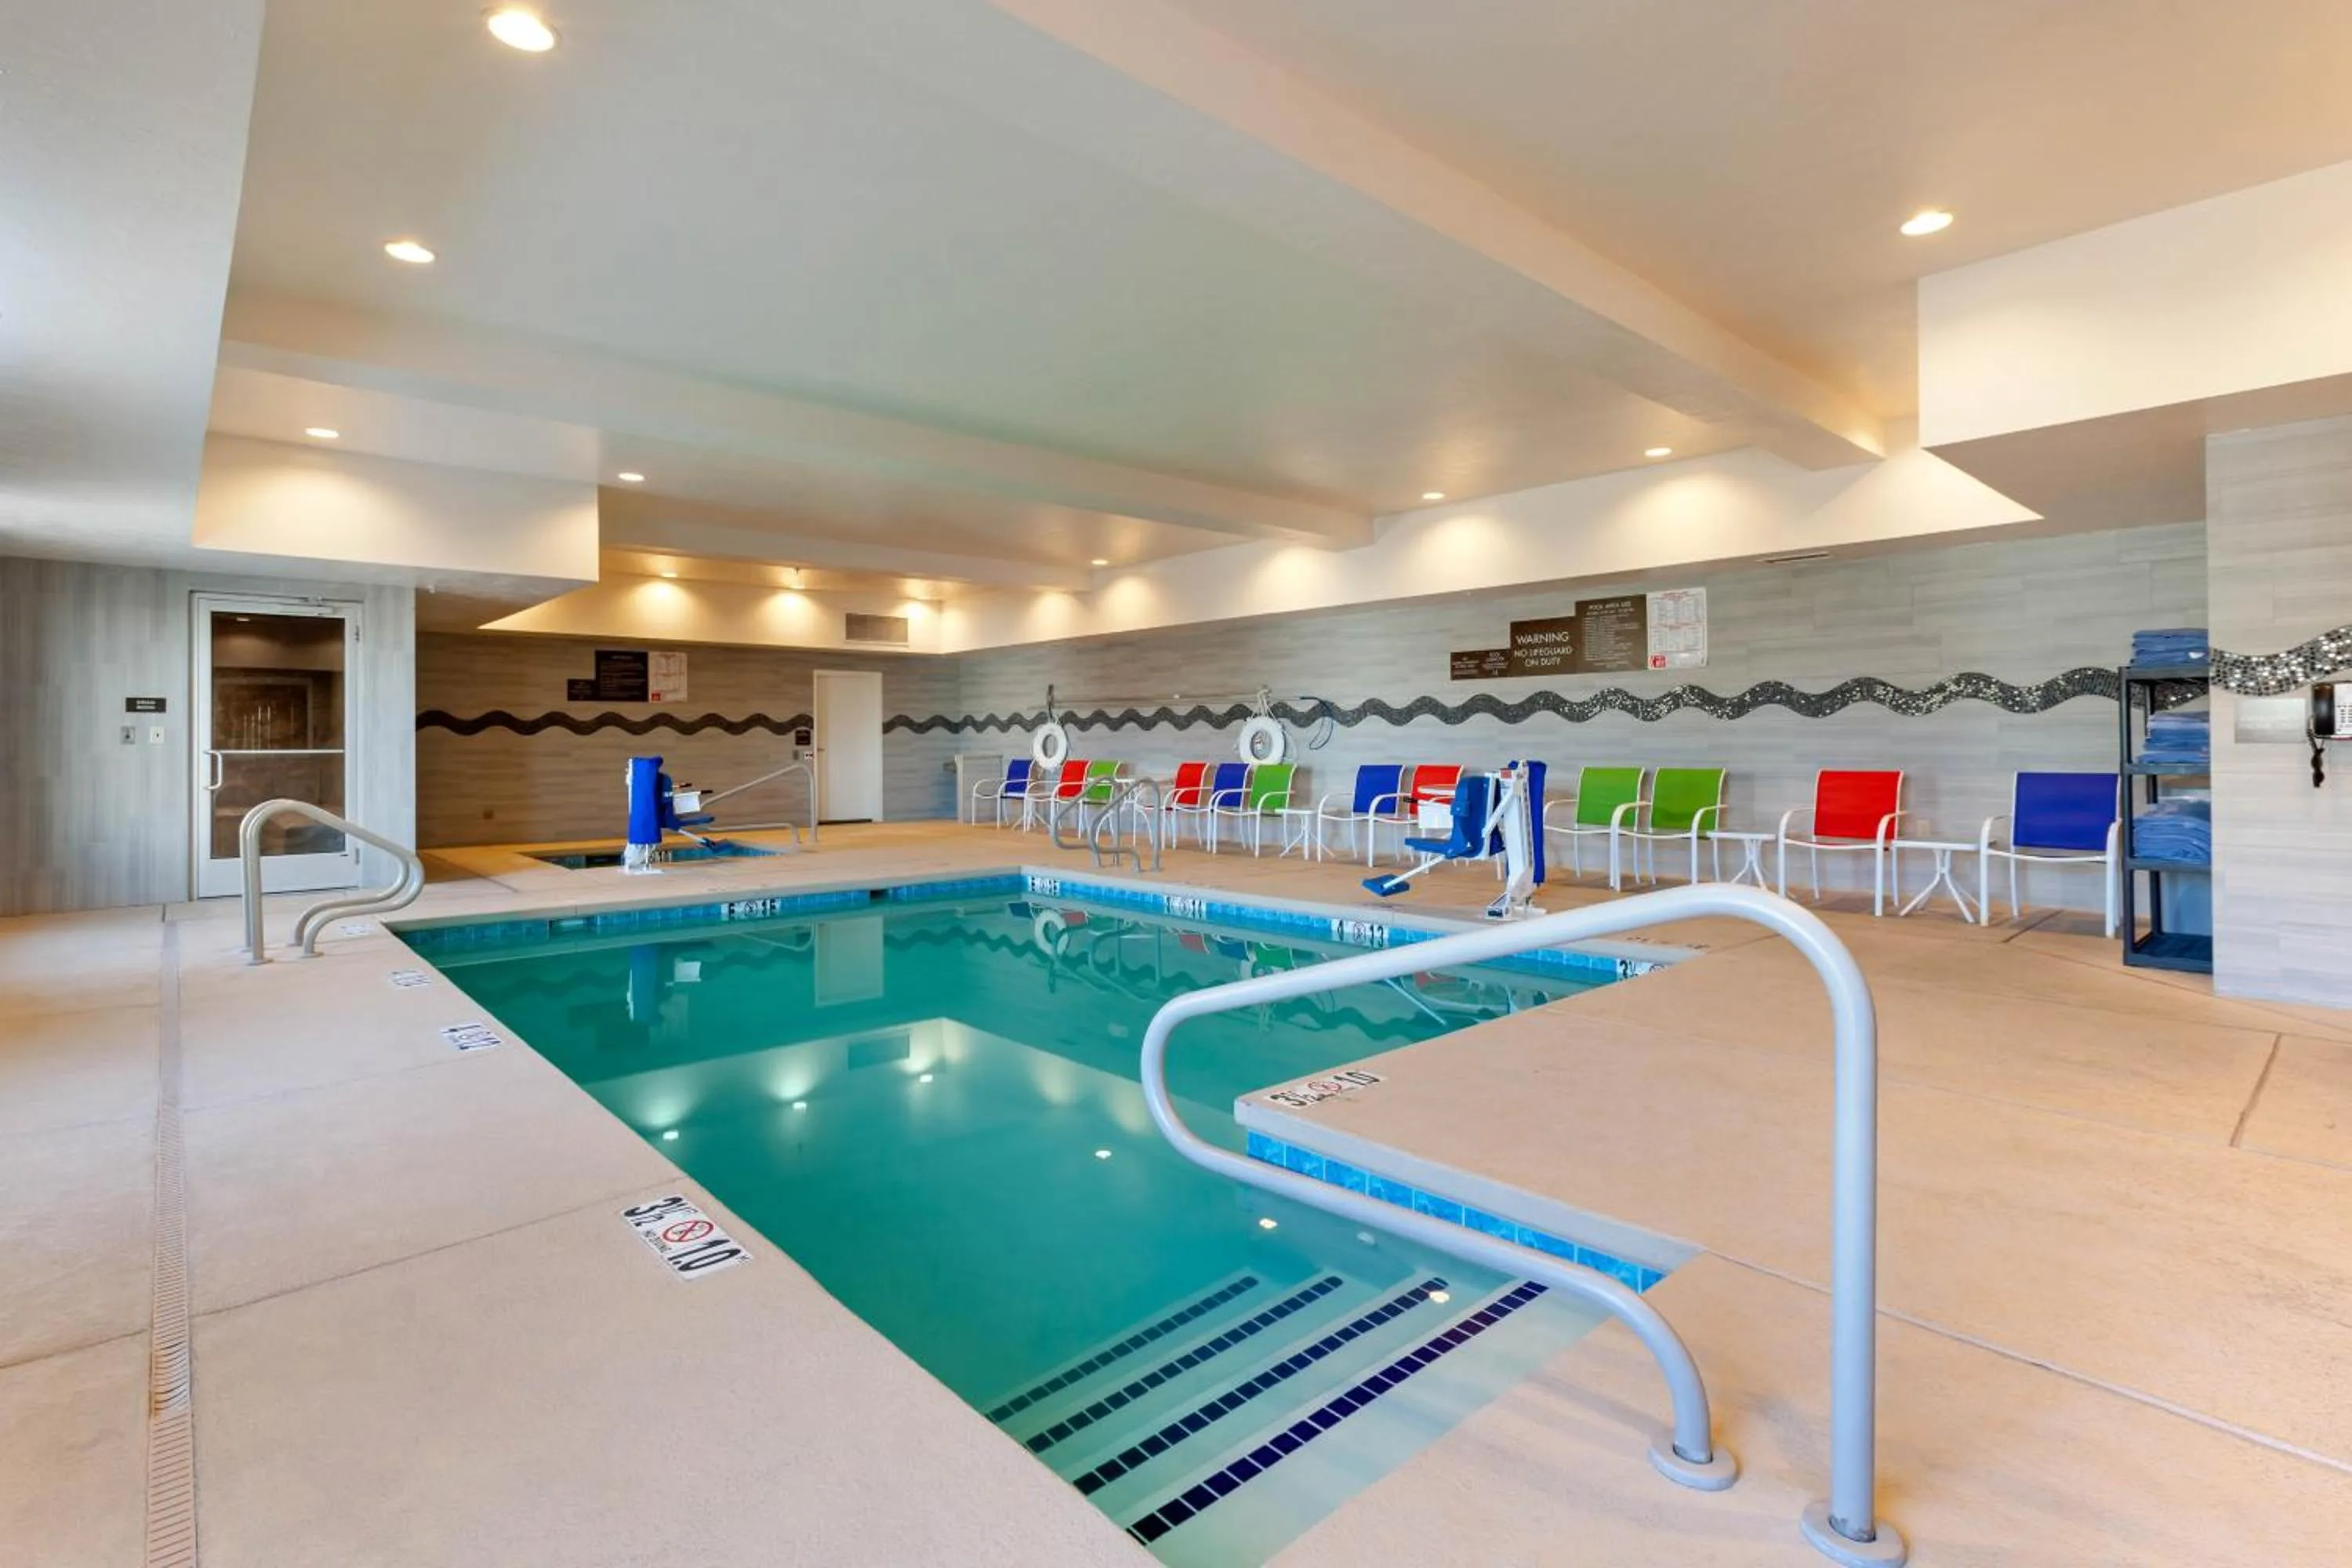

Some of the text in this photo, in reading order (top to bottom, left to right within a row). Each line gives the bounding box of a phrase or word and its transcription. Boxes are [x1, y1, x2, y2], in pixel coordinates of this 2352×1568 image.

[1515, 631, 1570, 644] WARNING
[1514, 645, 1573, 658] NO LIFEGUARD
[1525, 657, 1561, 667] ON DUTY
[667, 1240, 742, 1271] 1.0
